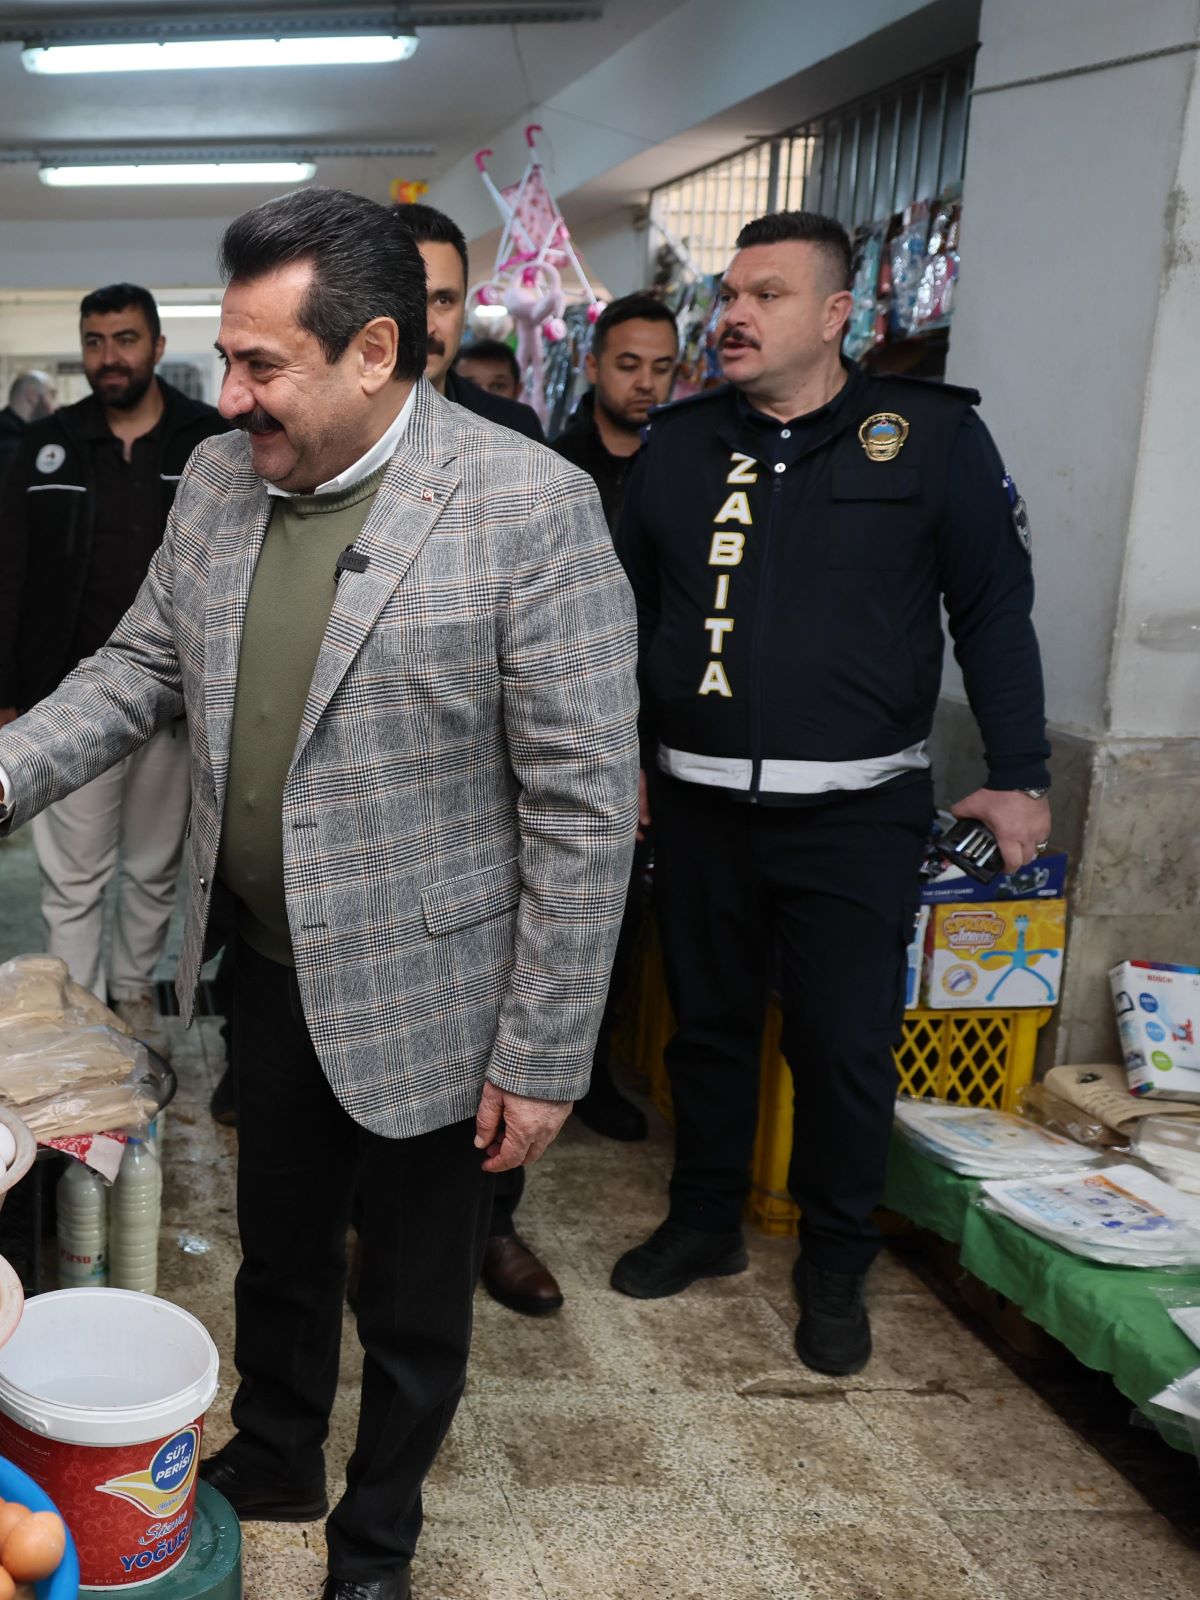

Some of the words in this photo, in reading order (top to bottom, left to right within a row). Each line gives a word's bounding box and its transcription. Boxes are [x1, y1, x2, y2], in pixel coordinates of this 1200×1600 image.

[698, 452, 758, 698] ZABITA
[155, 1449, 192, 1483] PERİSİ
[164, 1443, 188, 1464] SÜT
